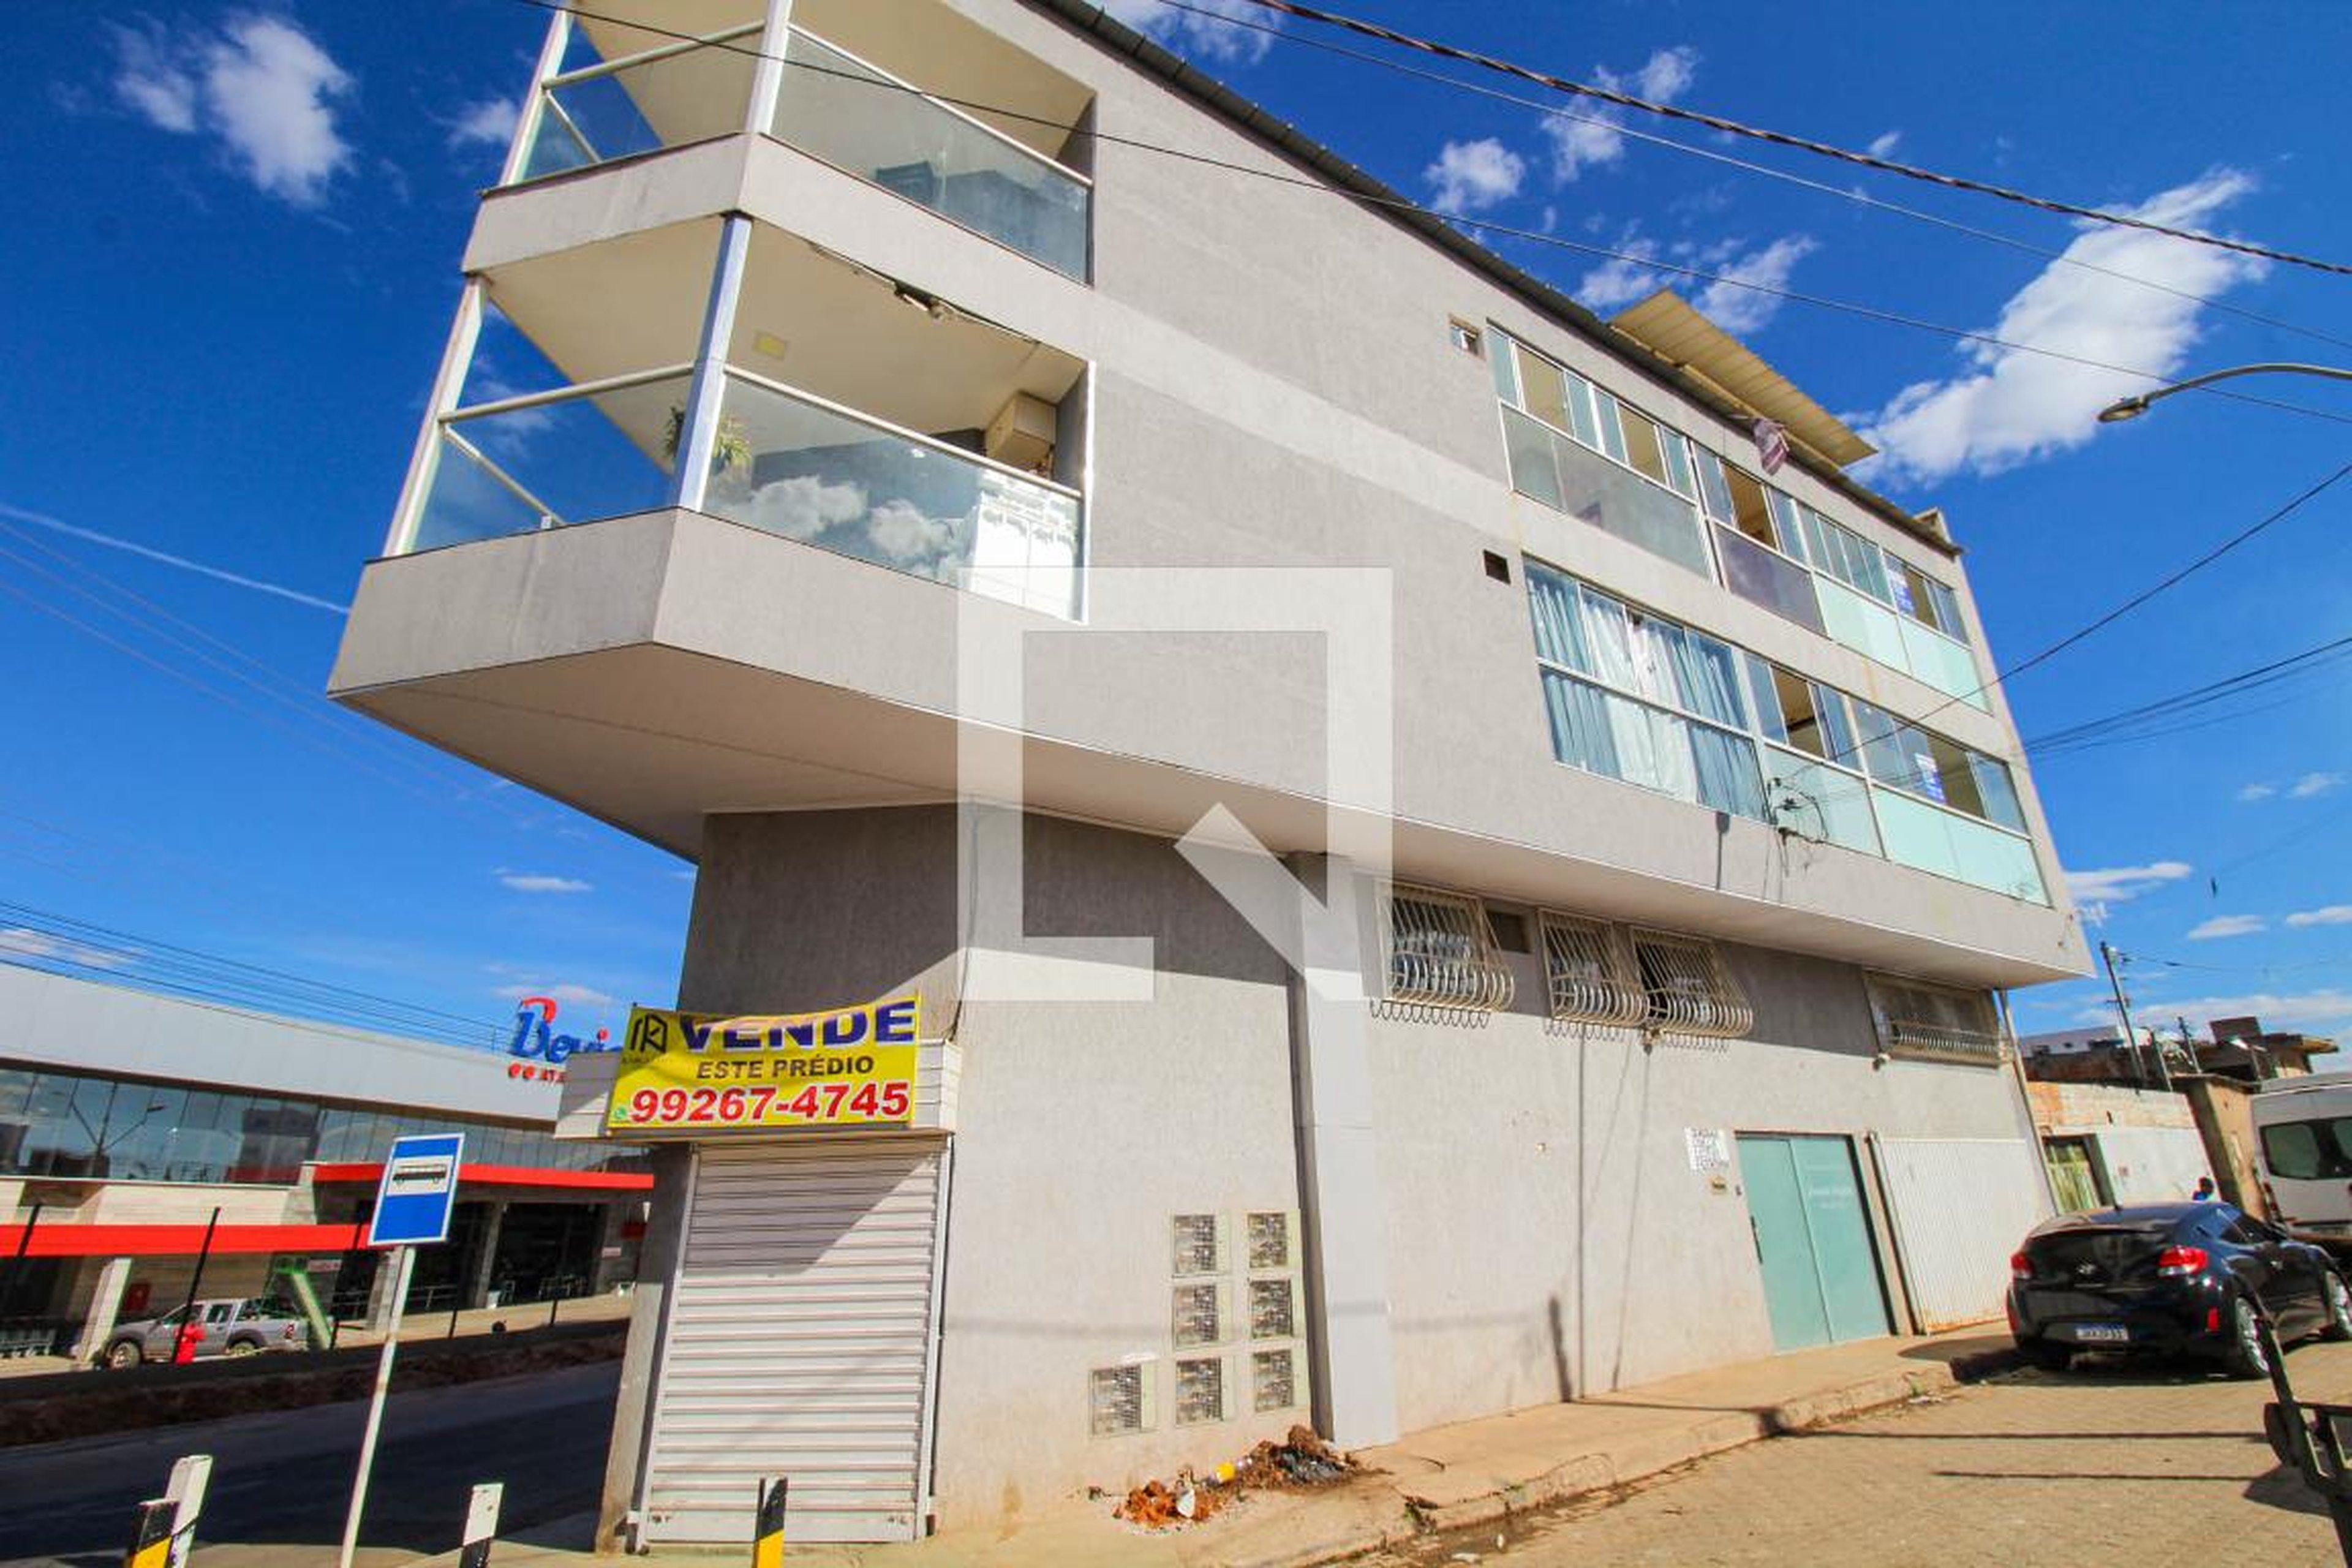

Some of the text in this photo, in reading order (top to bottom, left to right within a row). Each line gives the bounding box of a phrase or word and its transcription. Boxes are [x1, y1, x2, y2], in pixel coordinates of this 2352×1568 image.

[680, 1000, 916, 1052] VENDE
[696, 1054, 875, 1079] ESTE PRÉDIO
[631, 1082, 910, 1123] 99267-4745
